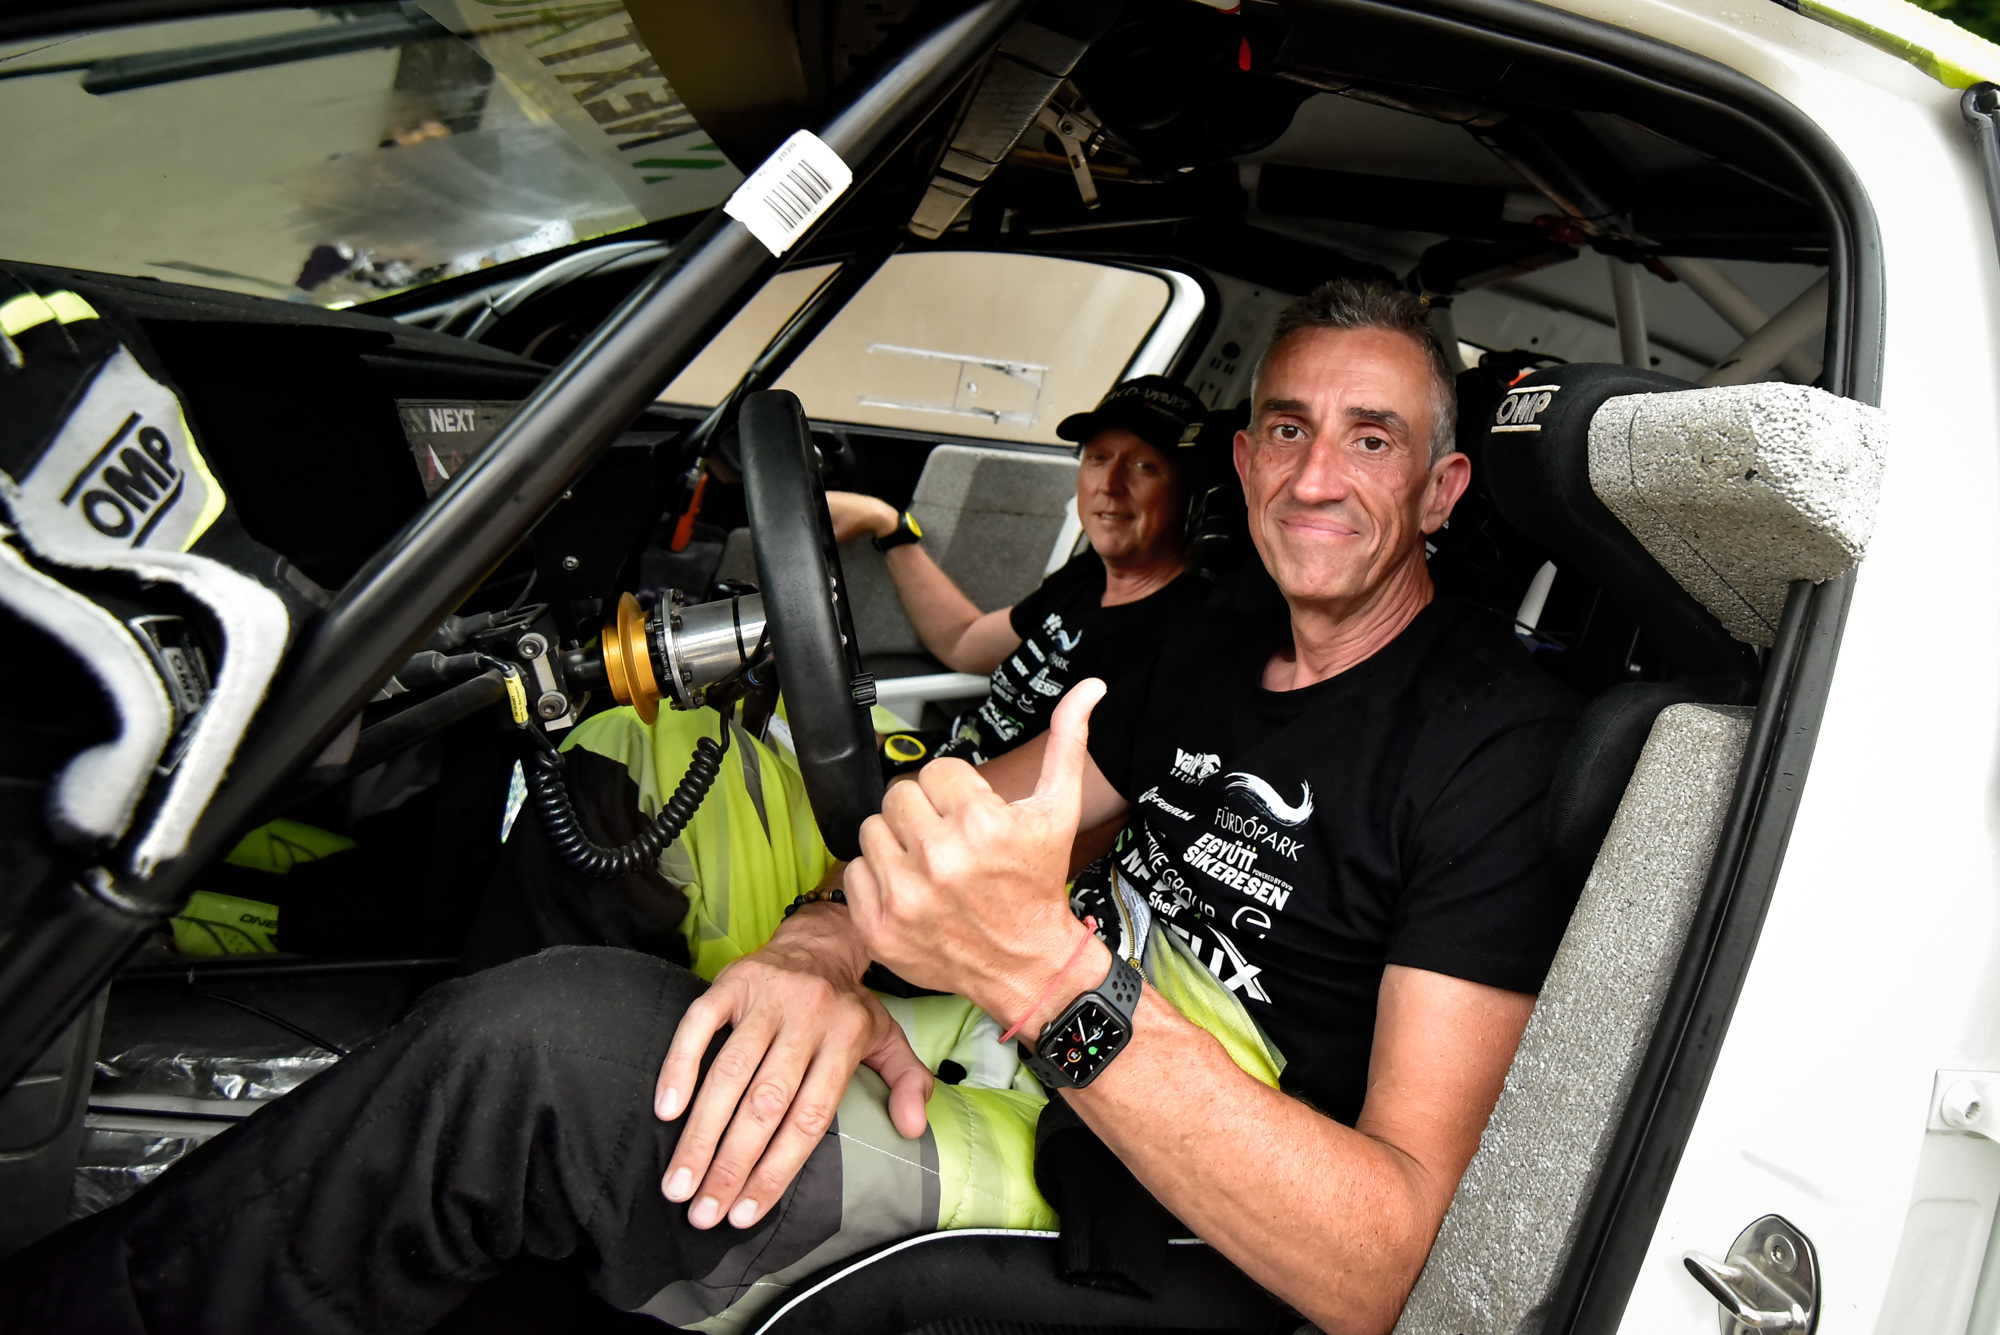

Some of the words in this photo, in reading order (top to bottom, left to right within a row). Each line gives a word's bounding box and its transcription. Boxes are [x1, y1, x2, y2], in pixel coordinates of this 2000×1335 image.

[429, 408, 475, 432] NEXT
[1496, 391, 1552, 425] OMP
[81, 426, 178, 539] OMP
[1214, 806, 1304, 862] FÜRDŐPARK
[1194, 832, 1258, 872] EGYÜTT
[1252, 869, 1274, 882] POWERED
[1149, 891, 1182, 918] Shell
